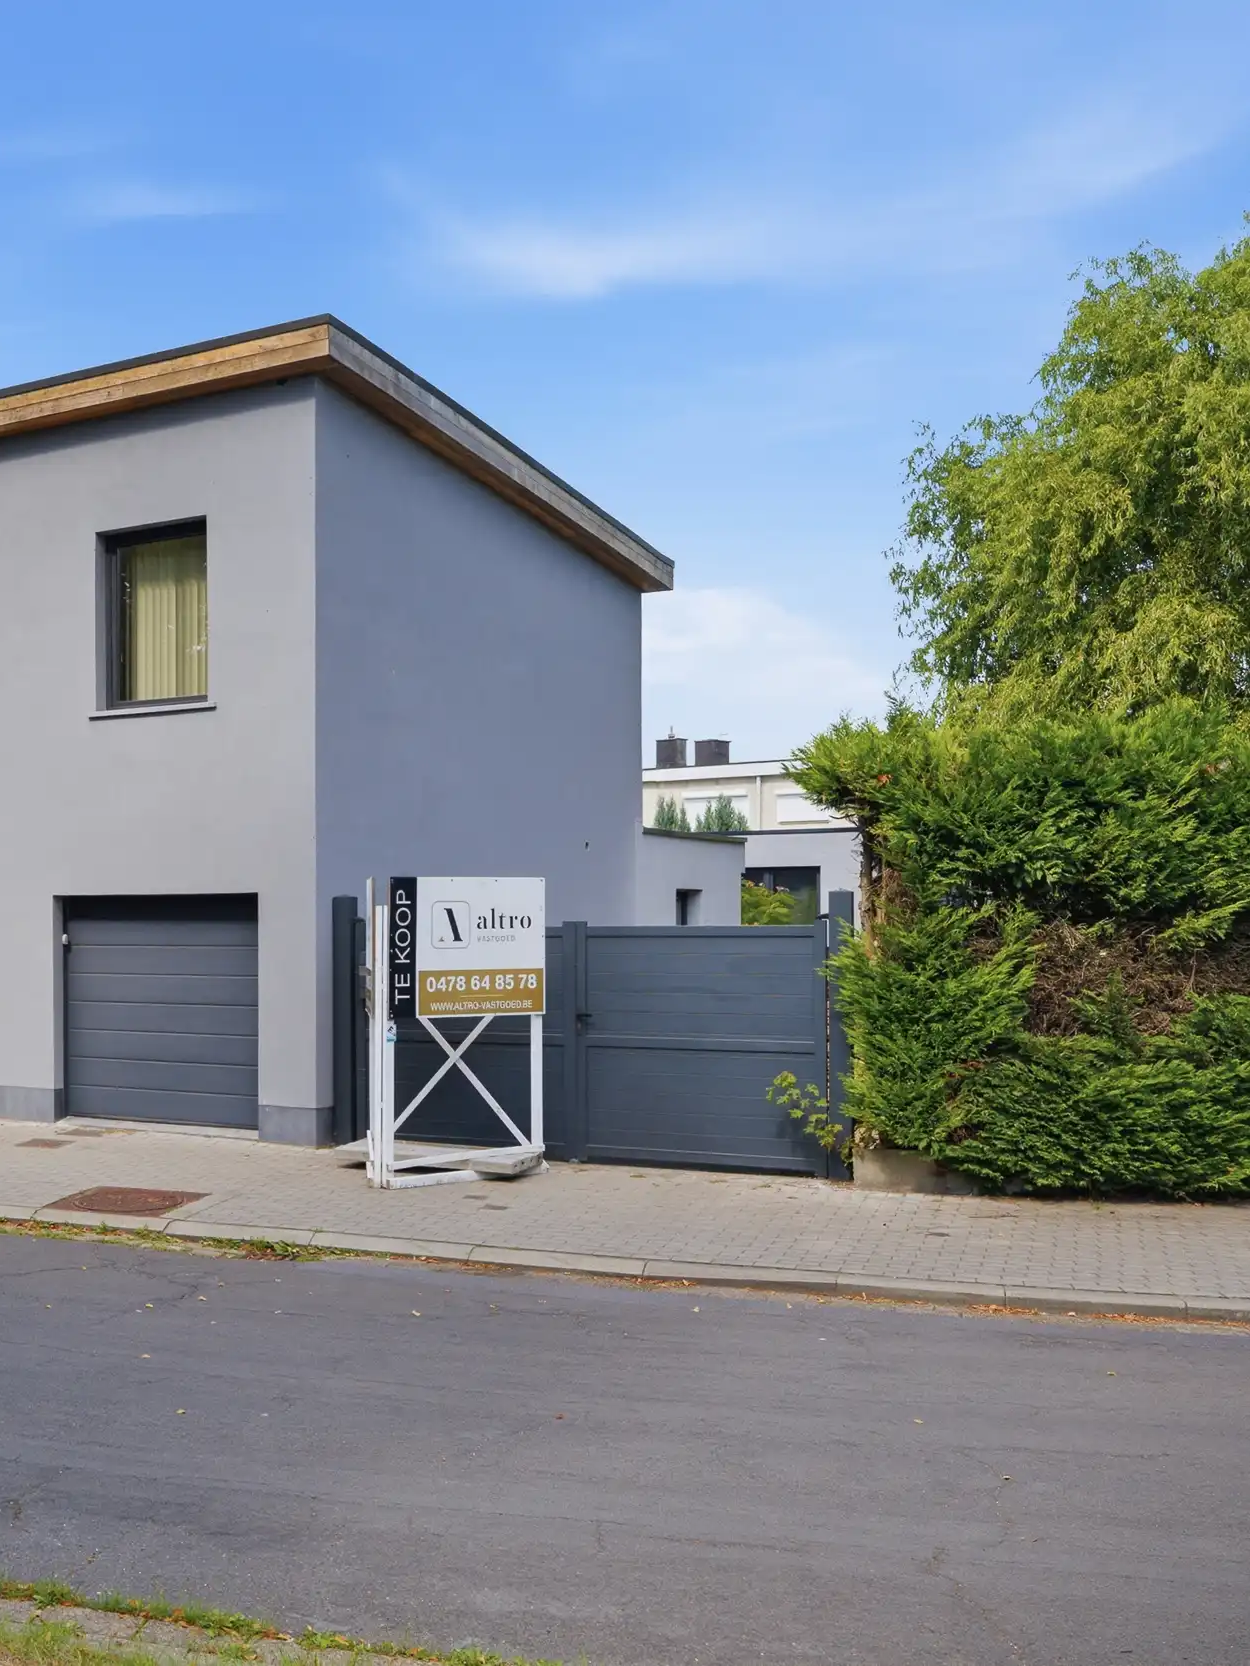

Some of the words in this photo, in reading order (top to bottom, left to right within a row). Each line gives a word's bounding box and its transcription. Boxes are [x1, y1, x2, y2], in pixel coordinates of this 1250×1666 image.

[395, 889, 411, 963] KOOP
[476, 908, 532, 930] altro
[476, 935, 516, 943] VASTGOED
[394, 973, 411, 1005] TE
[426, 975, 466, 992] 0478
[470, 974, 490, 991] 64
[494, 974, 514, 990] 85
[518, 973, 537, 989] 78
[430, 999, 533, 1011] WWW.ALTRO-VASTGOED.BE
